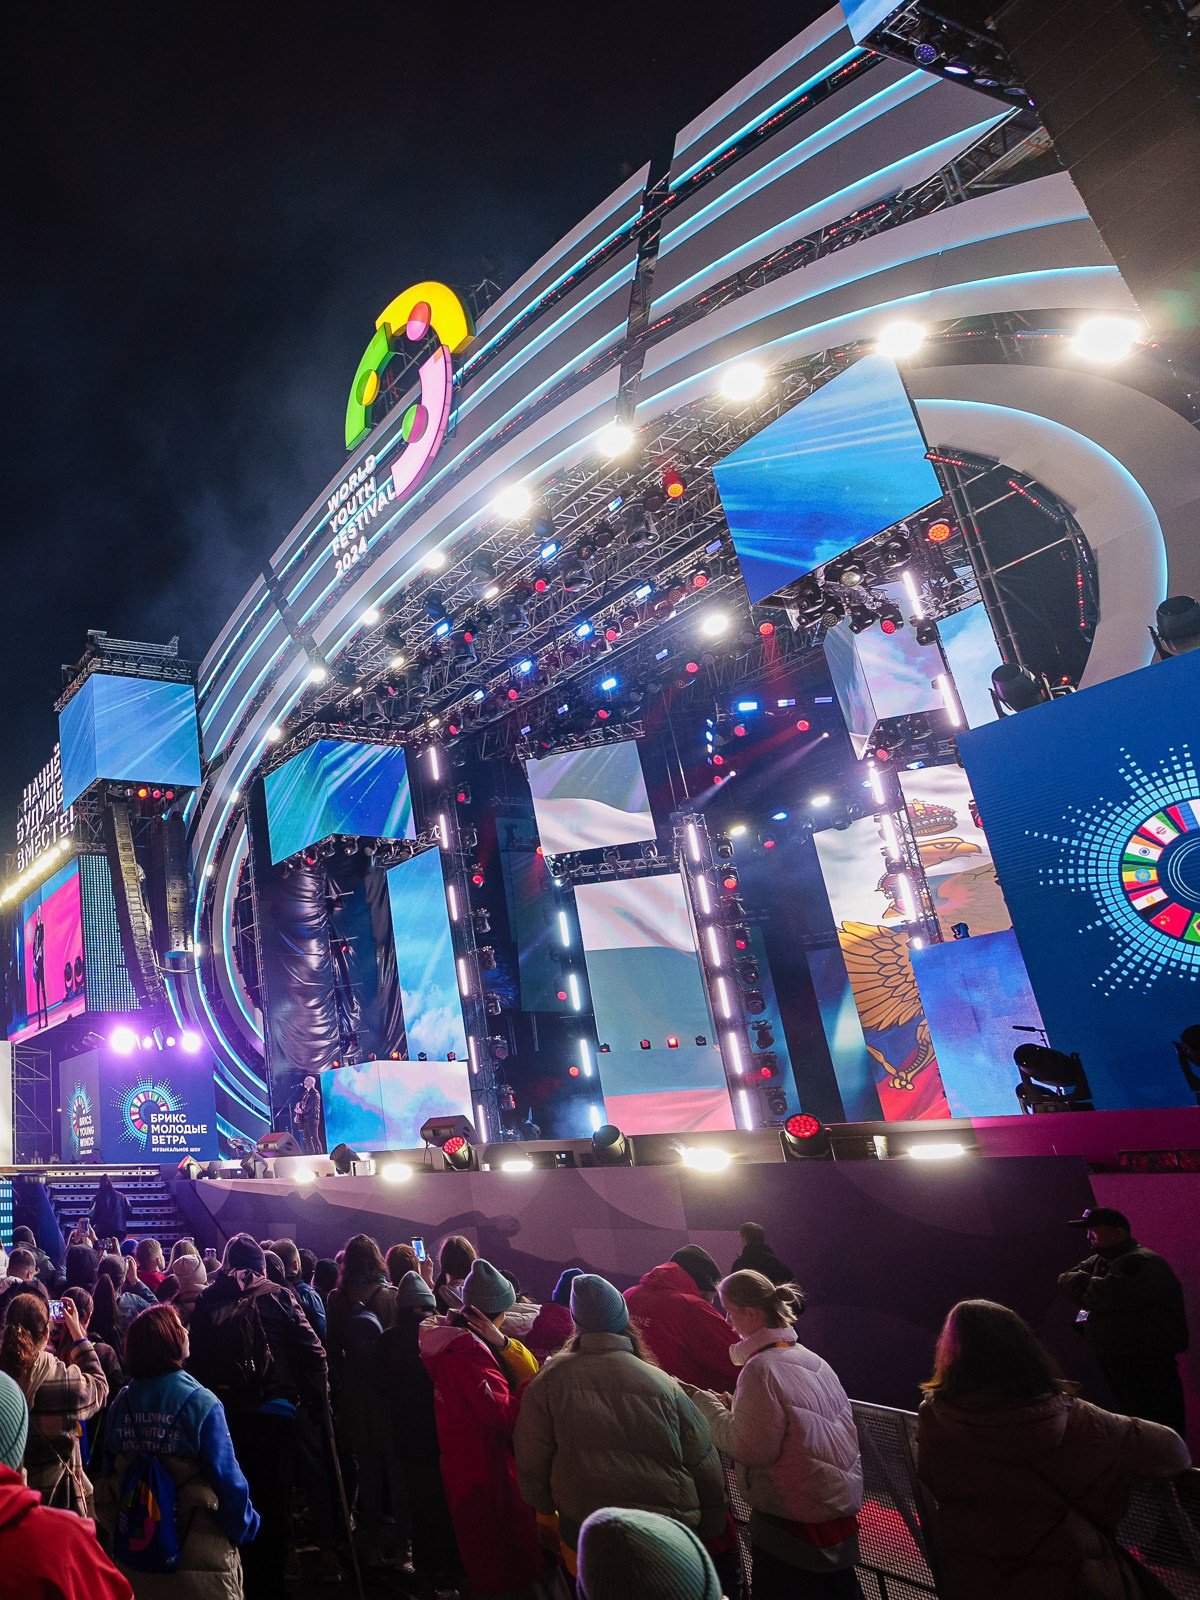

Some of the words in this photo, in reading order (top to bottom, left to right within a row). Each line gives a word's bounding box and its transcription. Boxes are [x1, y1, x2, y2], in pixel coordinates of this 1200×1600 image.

[327, 454, 378, 513] WORLD
[329, 476, 378, 533] YOUTH
[331, 484, 397, 557] FESTIVAL
[334, 535, 369, 578] 2024
[79, 1115, 93, 1127] BRICS
[150, 1113, 187, 1123] БРИКС
[79, 1125, 95, 1137] YOUNG
[151, 1124, 208, 1134] МОЛОДЫЕ
[151, 1135, 187, 1145] ВЕТРА
